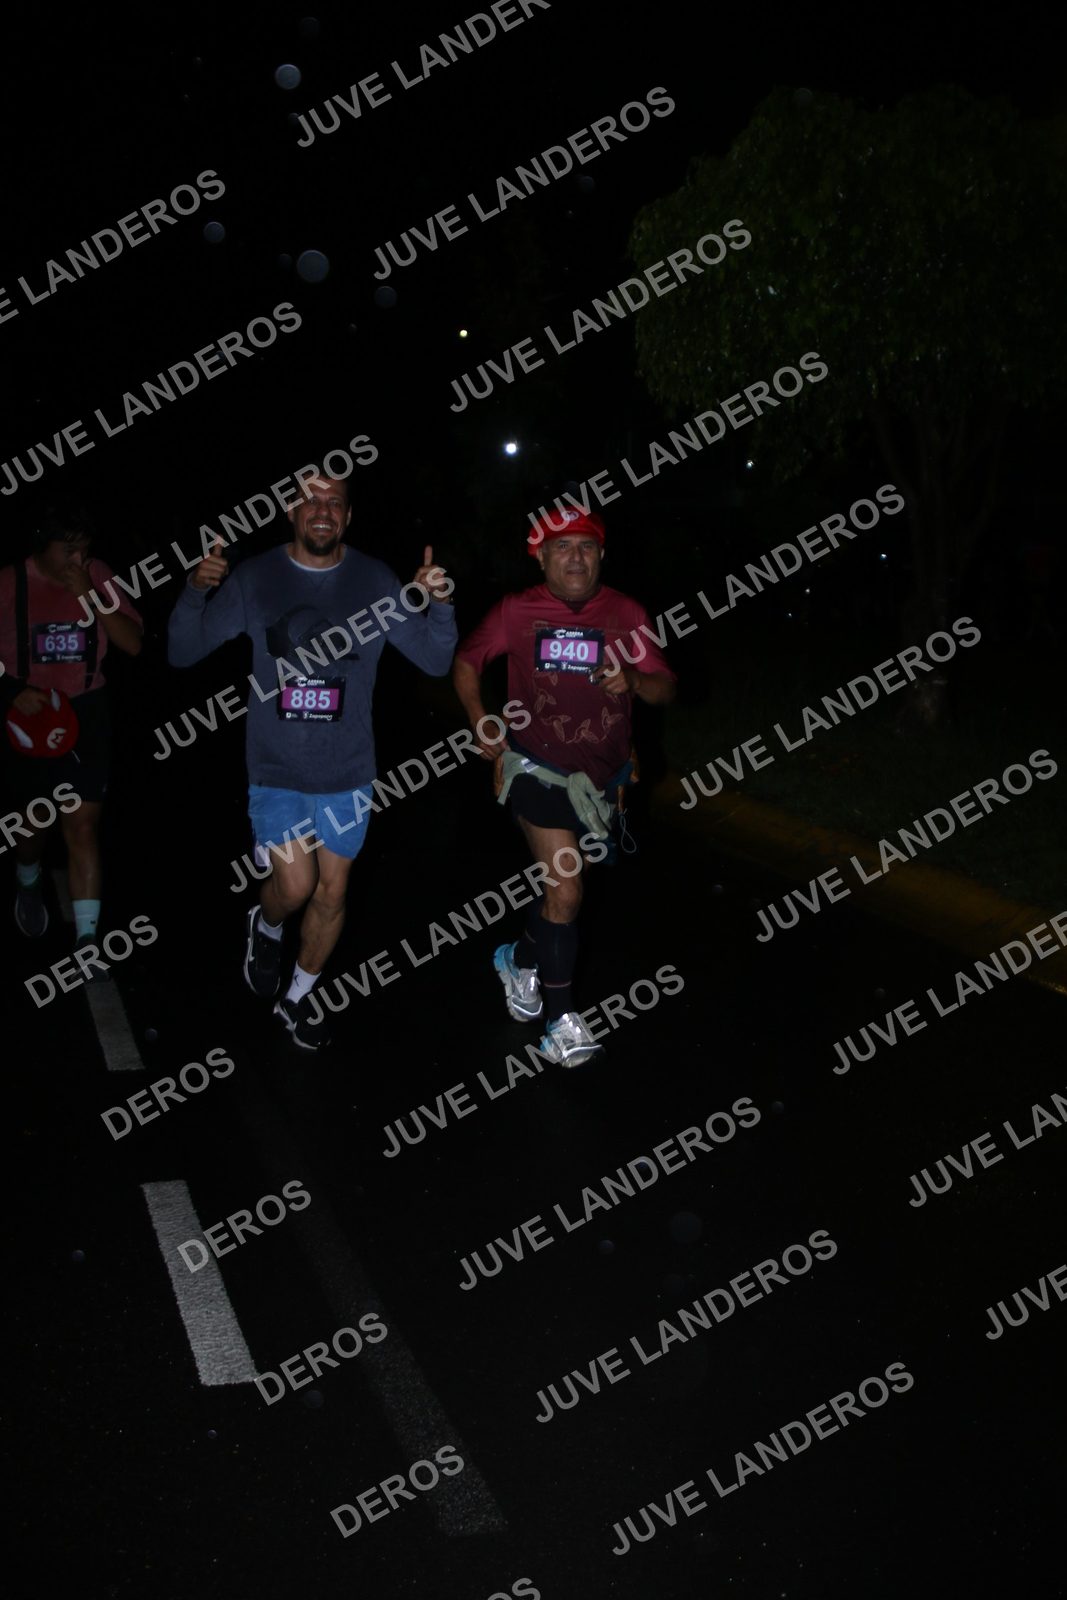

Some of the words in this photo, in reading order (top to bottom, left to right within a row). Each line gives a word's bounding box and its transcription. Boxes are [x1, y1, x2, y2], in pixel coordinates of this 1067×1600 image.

[45, 635, 79, 652] 635
[549, 640, 589, 661] 940
[290, 689, 331, 710] 885
